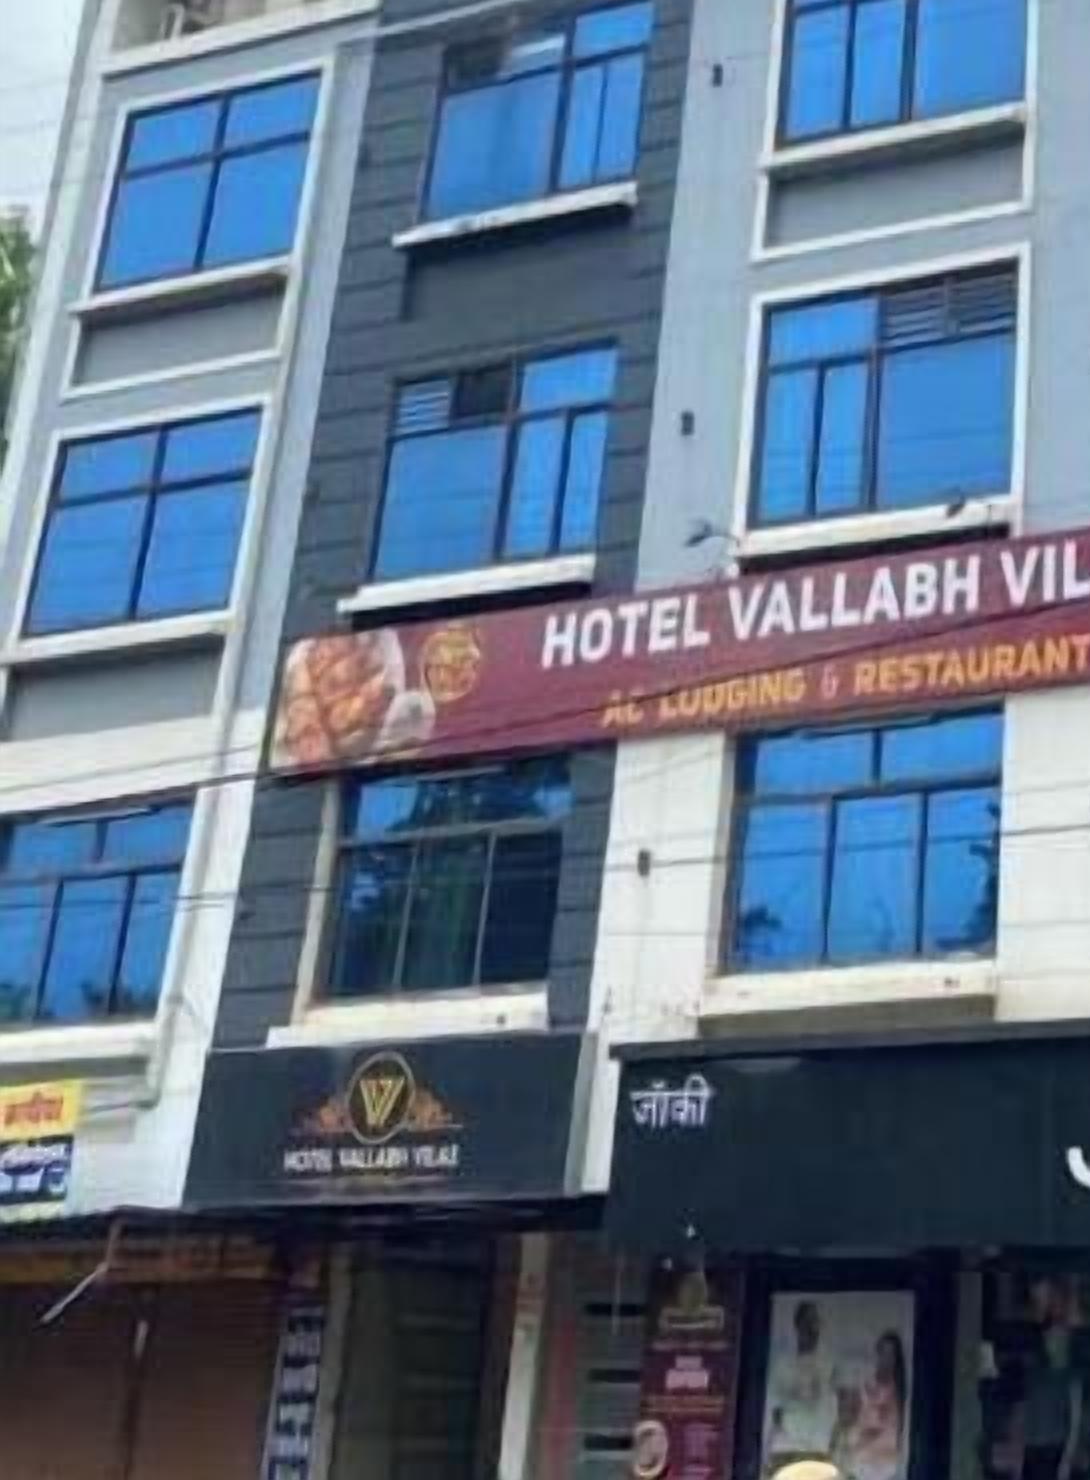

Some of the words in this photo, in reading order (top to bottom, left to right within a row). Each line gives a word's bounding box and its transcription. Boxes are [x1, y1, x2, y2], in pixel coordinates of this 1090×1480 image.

[542, 591, 711, 670] HOTEL
[728, 554, 981, 642] VALLABH
[658, 668, 807, 720] LODGING
[629, 1073, 714, 1128] जॉकी
